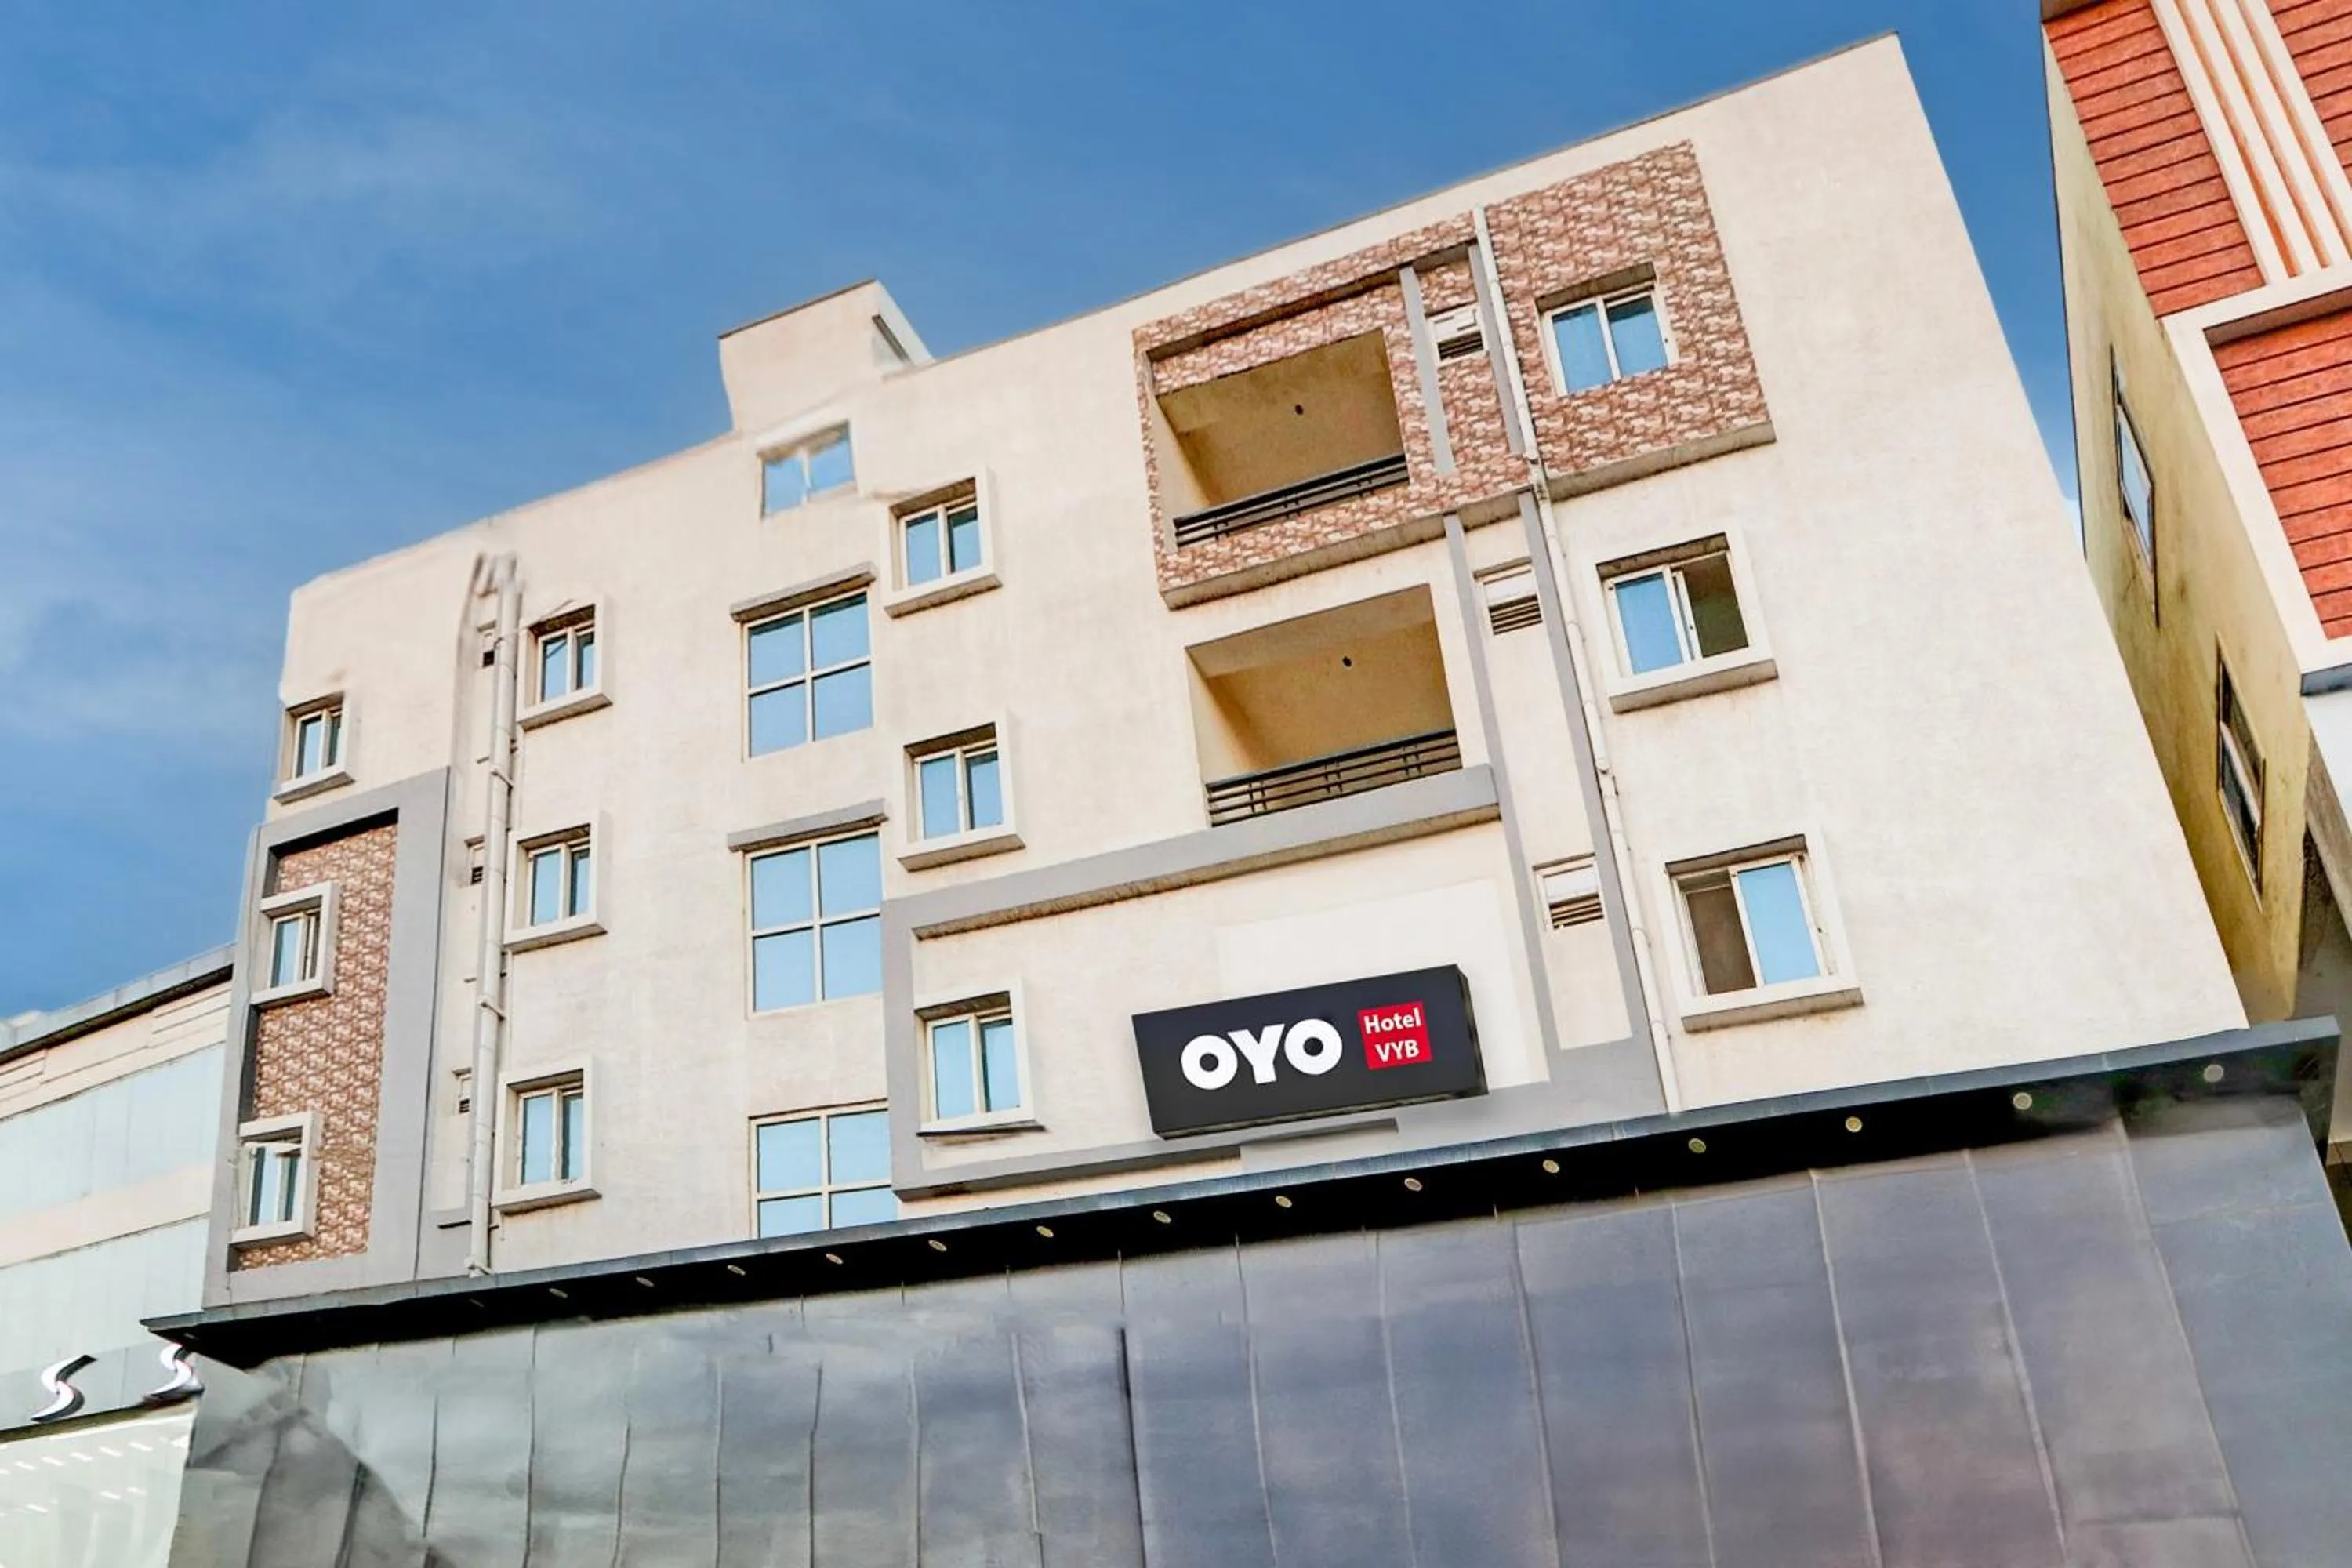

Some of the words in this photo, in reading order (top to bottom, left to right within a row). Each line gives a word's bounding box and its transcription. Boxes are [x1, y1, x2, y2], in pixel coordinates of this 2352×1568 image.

[1363, 1007, 1421, 1034] Hotel
[1181, 1018, 1343, 1090] OYO
[1374, 1039, 1420, 1062] VYB
